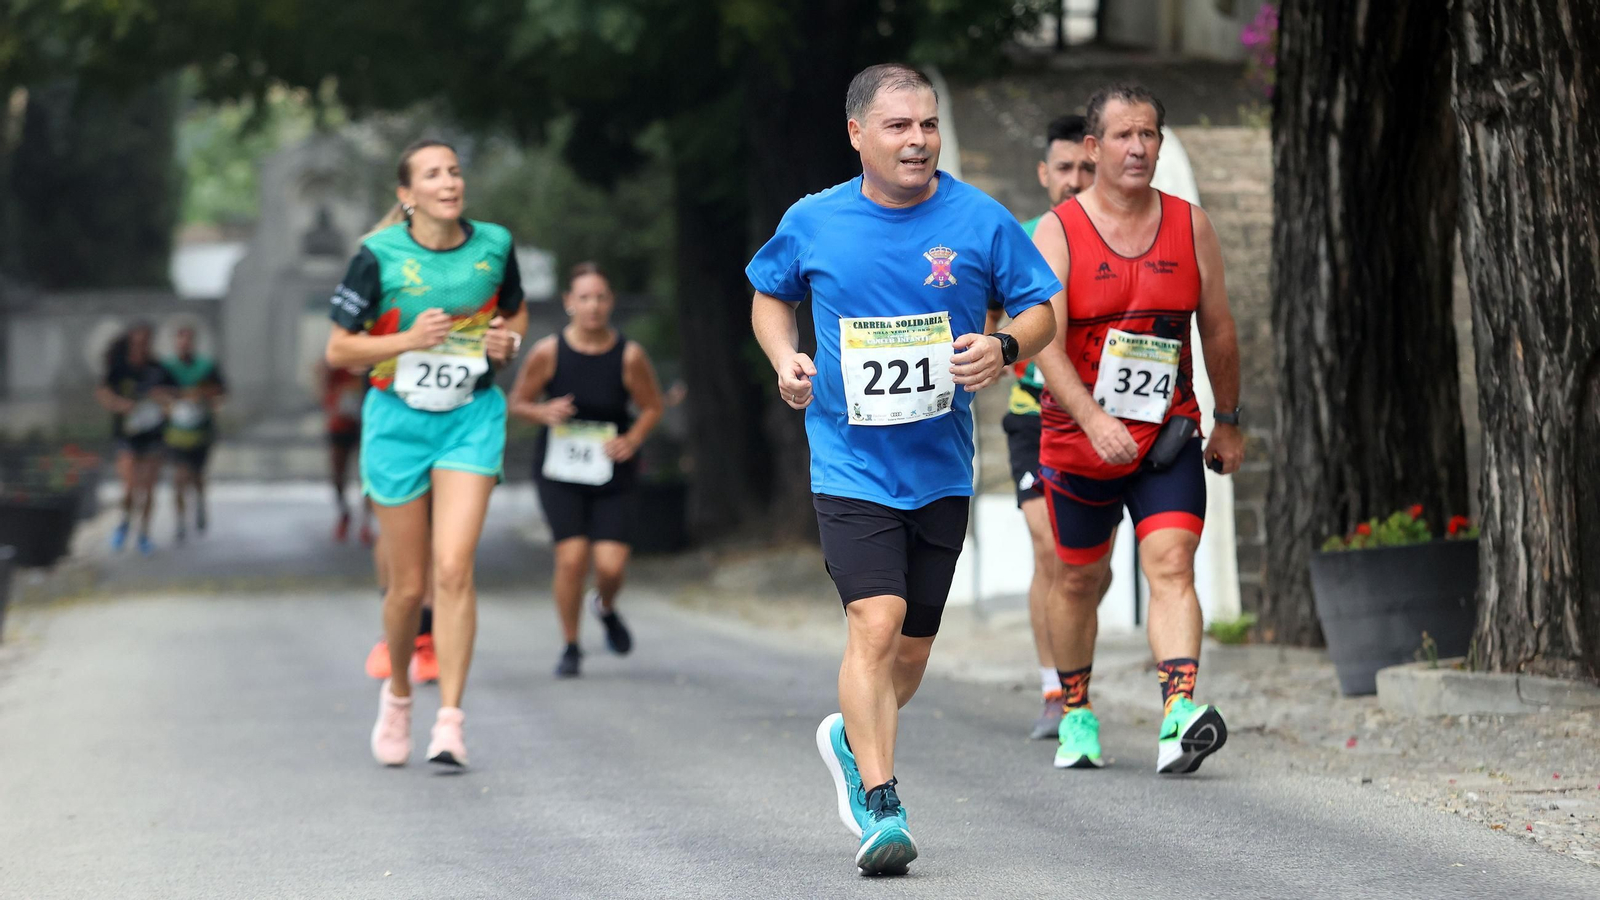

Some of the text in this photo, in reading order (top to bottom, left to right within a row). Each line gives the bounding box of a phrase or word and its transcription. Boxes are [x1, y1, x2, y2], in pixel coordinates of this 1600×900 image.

[853, 316, 943, 329] CARRERA SOLIDARIA
[416, 363, 470, 388] 262
[863, 357, 935, 395] 221
[1114, 367, 1170, 399] 324
